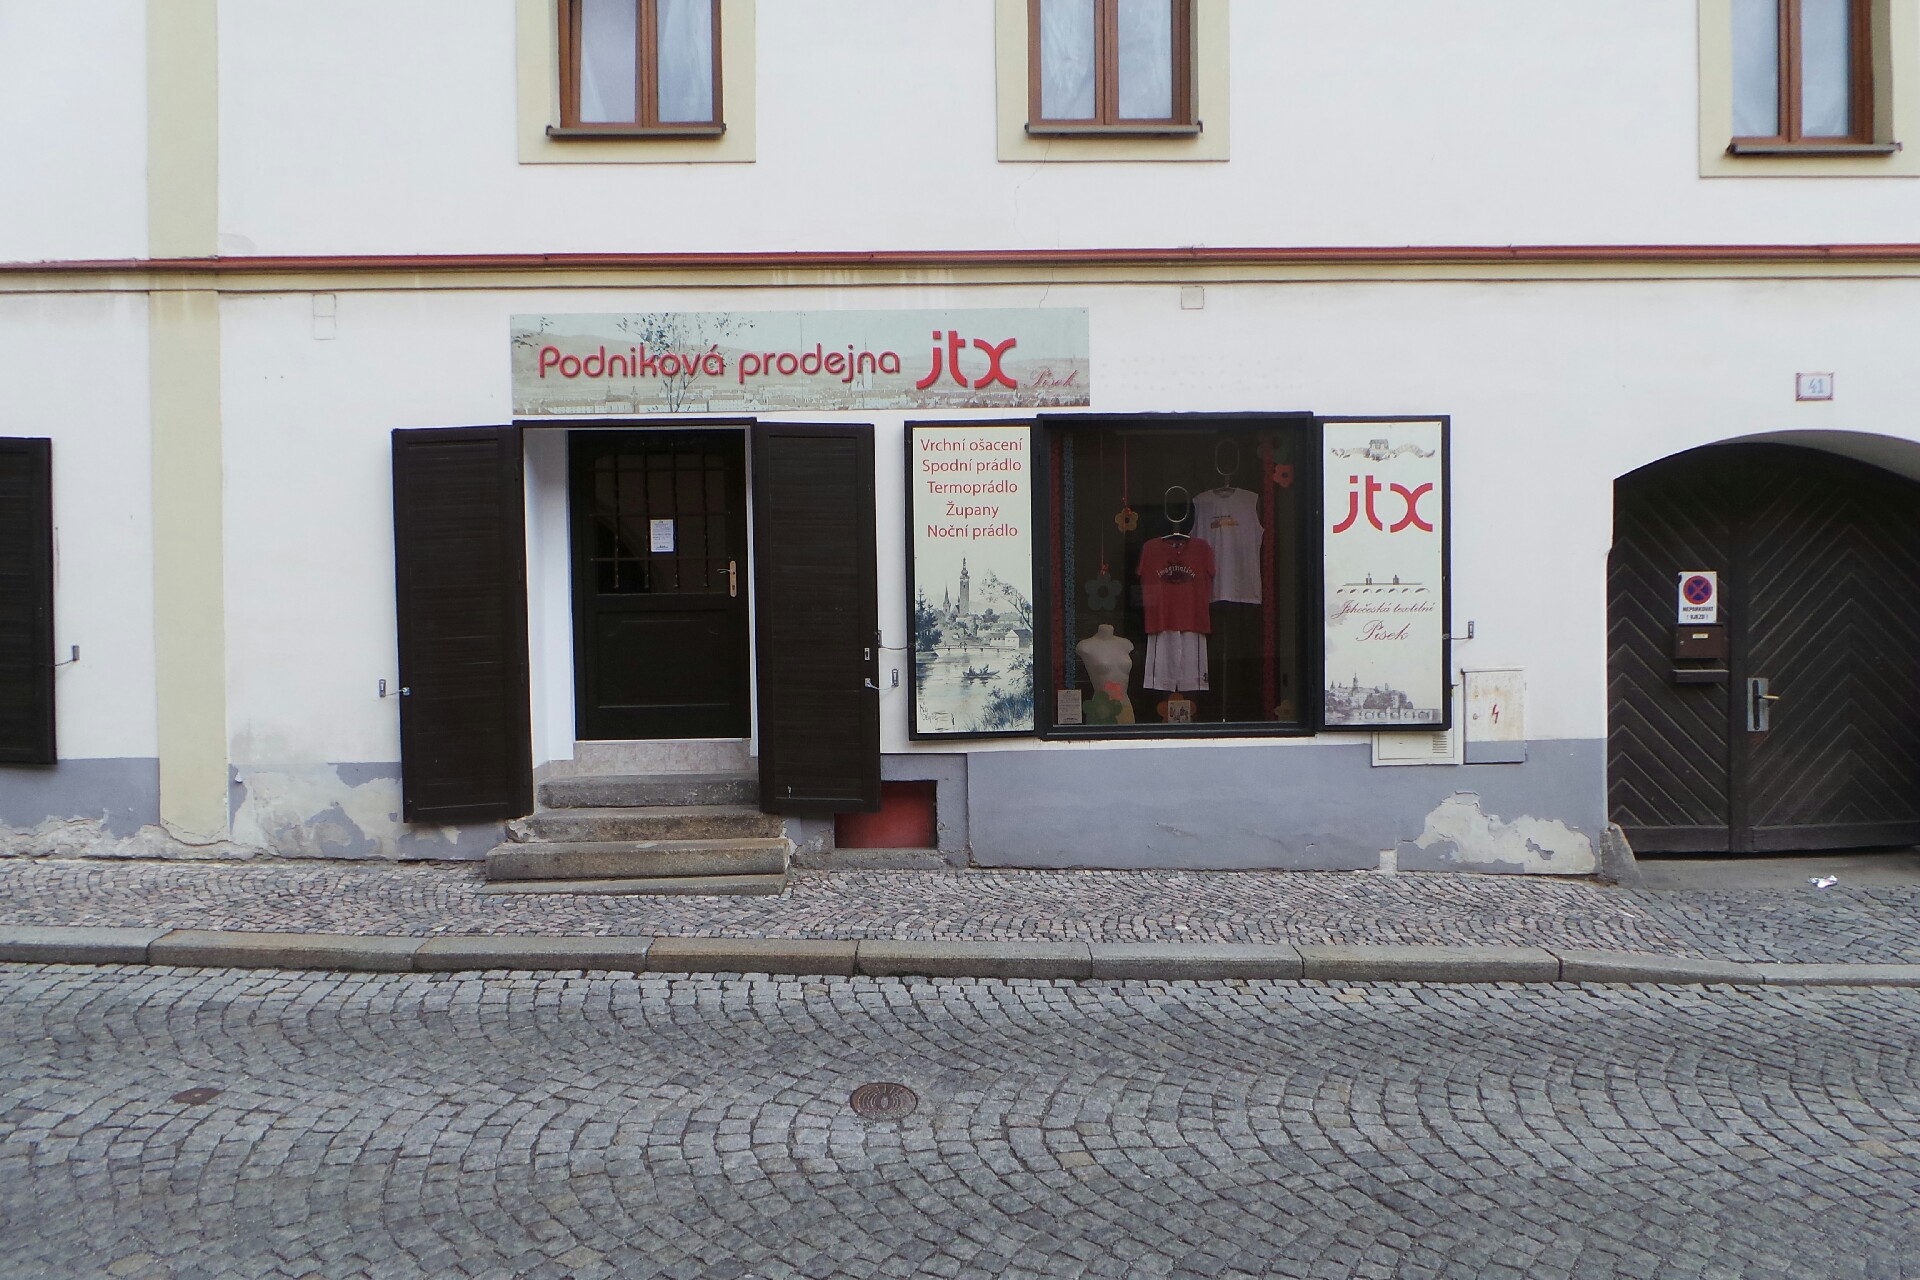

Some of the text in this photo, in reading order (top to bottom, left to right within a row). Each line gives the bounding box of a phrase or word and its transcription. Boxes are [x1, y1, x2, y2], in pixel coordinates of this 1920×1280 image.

[539, 342, 901, 384] Podniková prodejna
[916, 330, 1018, 390] jtx
[1808, 378, 1824, 394] 41
[920, 438, 1023, 452] Vrchní ošacení
[922, 458, 1022, 475] Spodní prádlo
[926, 479, 1018, 496] Termoprádlo
[945, 500, 999, 519] Župany
[1332, 474, 1434, 534] jtx
[927, 523, 1018, 540] Noční prádlo
